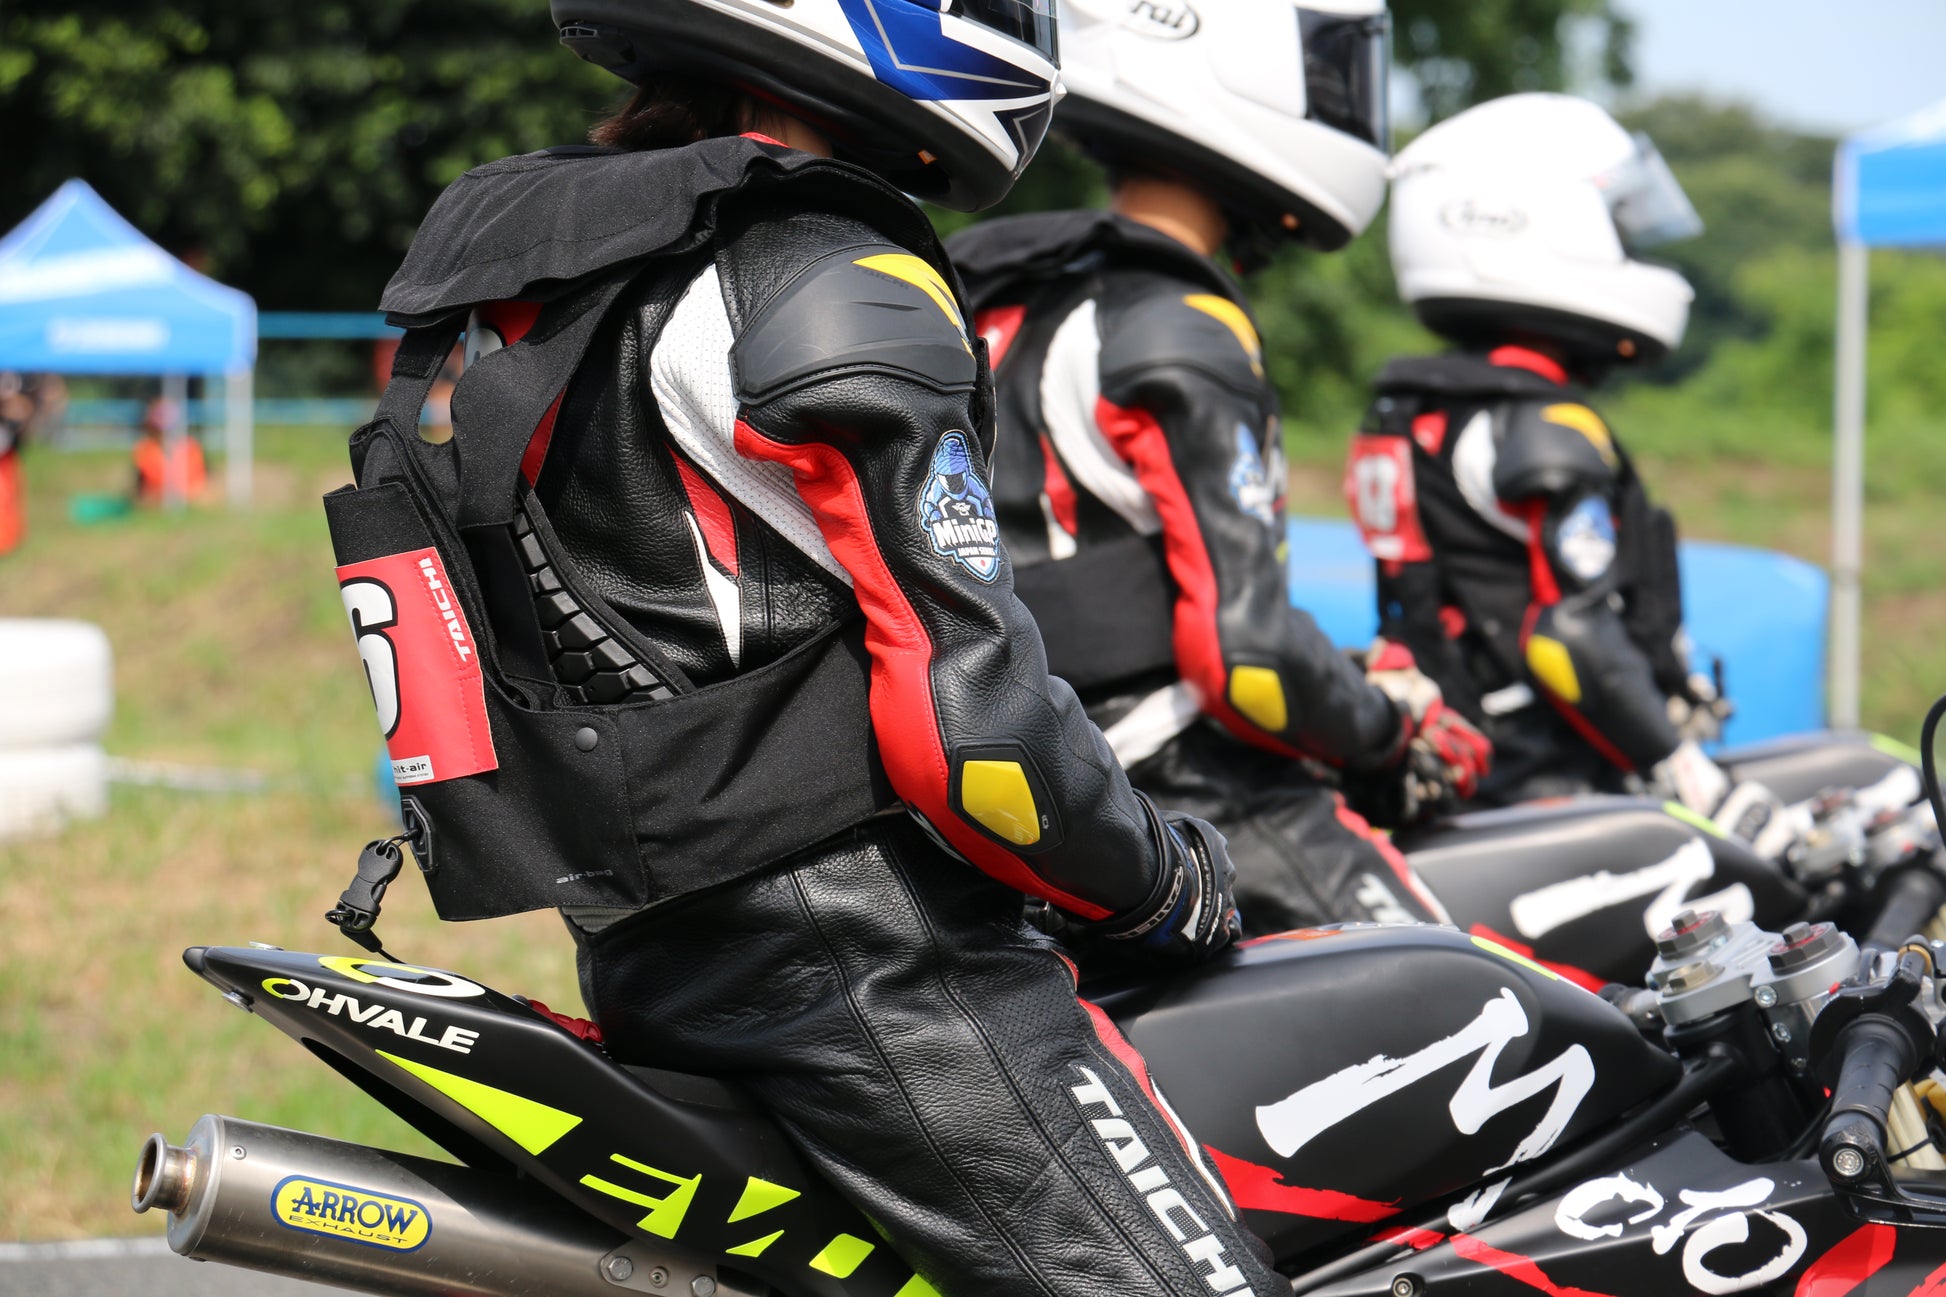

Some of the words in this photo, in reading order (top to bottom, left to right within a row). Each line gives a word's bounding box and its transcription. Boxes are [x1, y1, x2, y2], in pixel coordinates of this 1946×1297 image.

[1128, 0, 1188, 29] rai
[932, 517, 997, 550] MiniGP
[418, 557, 472, 663] TAICHI
[261, 977, 481, 1055] OHVALE
[289, 1214, 408, 1244] EXHAUST
[291, 1186, 418, 1235] ARROW
